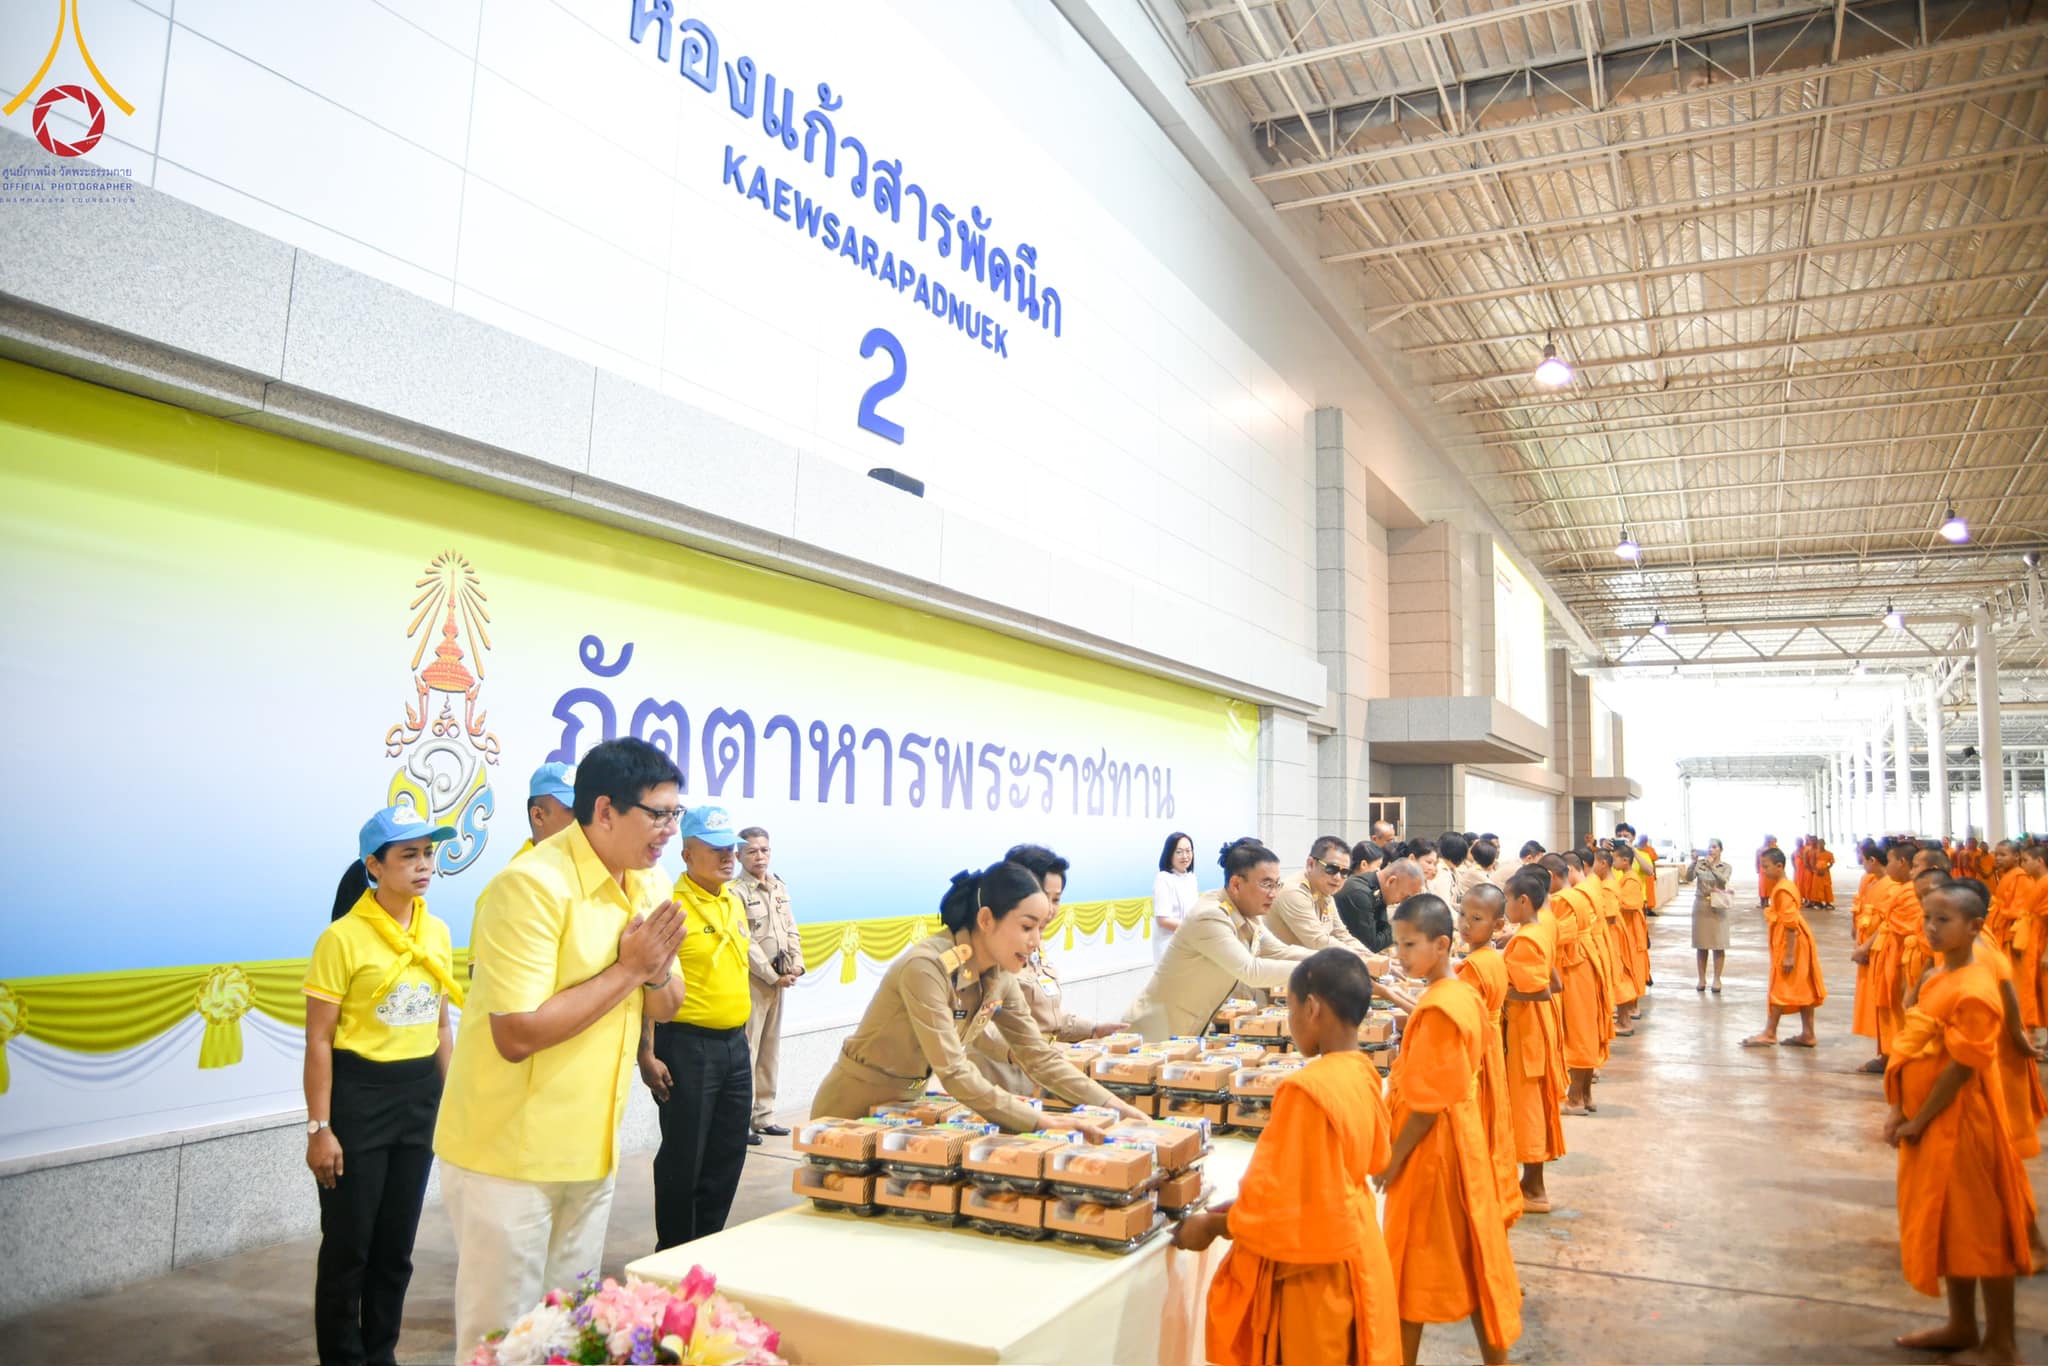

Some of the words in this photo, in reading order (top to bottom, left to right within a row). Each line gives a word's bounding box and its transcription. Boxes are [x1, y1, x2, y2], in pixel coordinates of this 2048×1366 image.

[630, 0, 1062, 338] หองแก้วสารพัดนึก
[723, 145, 1008, 358] KAEWSARAPADNUEK
[857, 328, 907, 445] 2
[545, 634, 1175, 819] ภัตตาหารพระราชทาน
